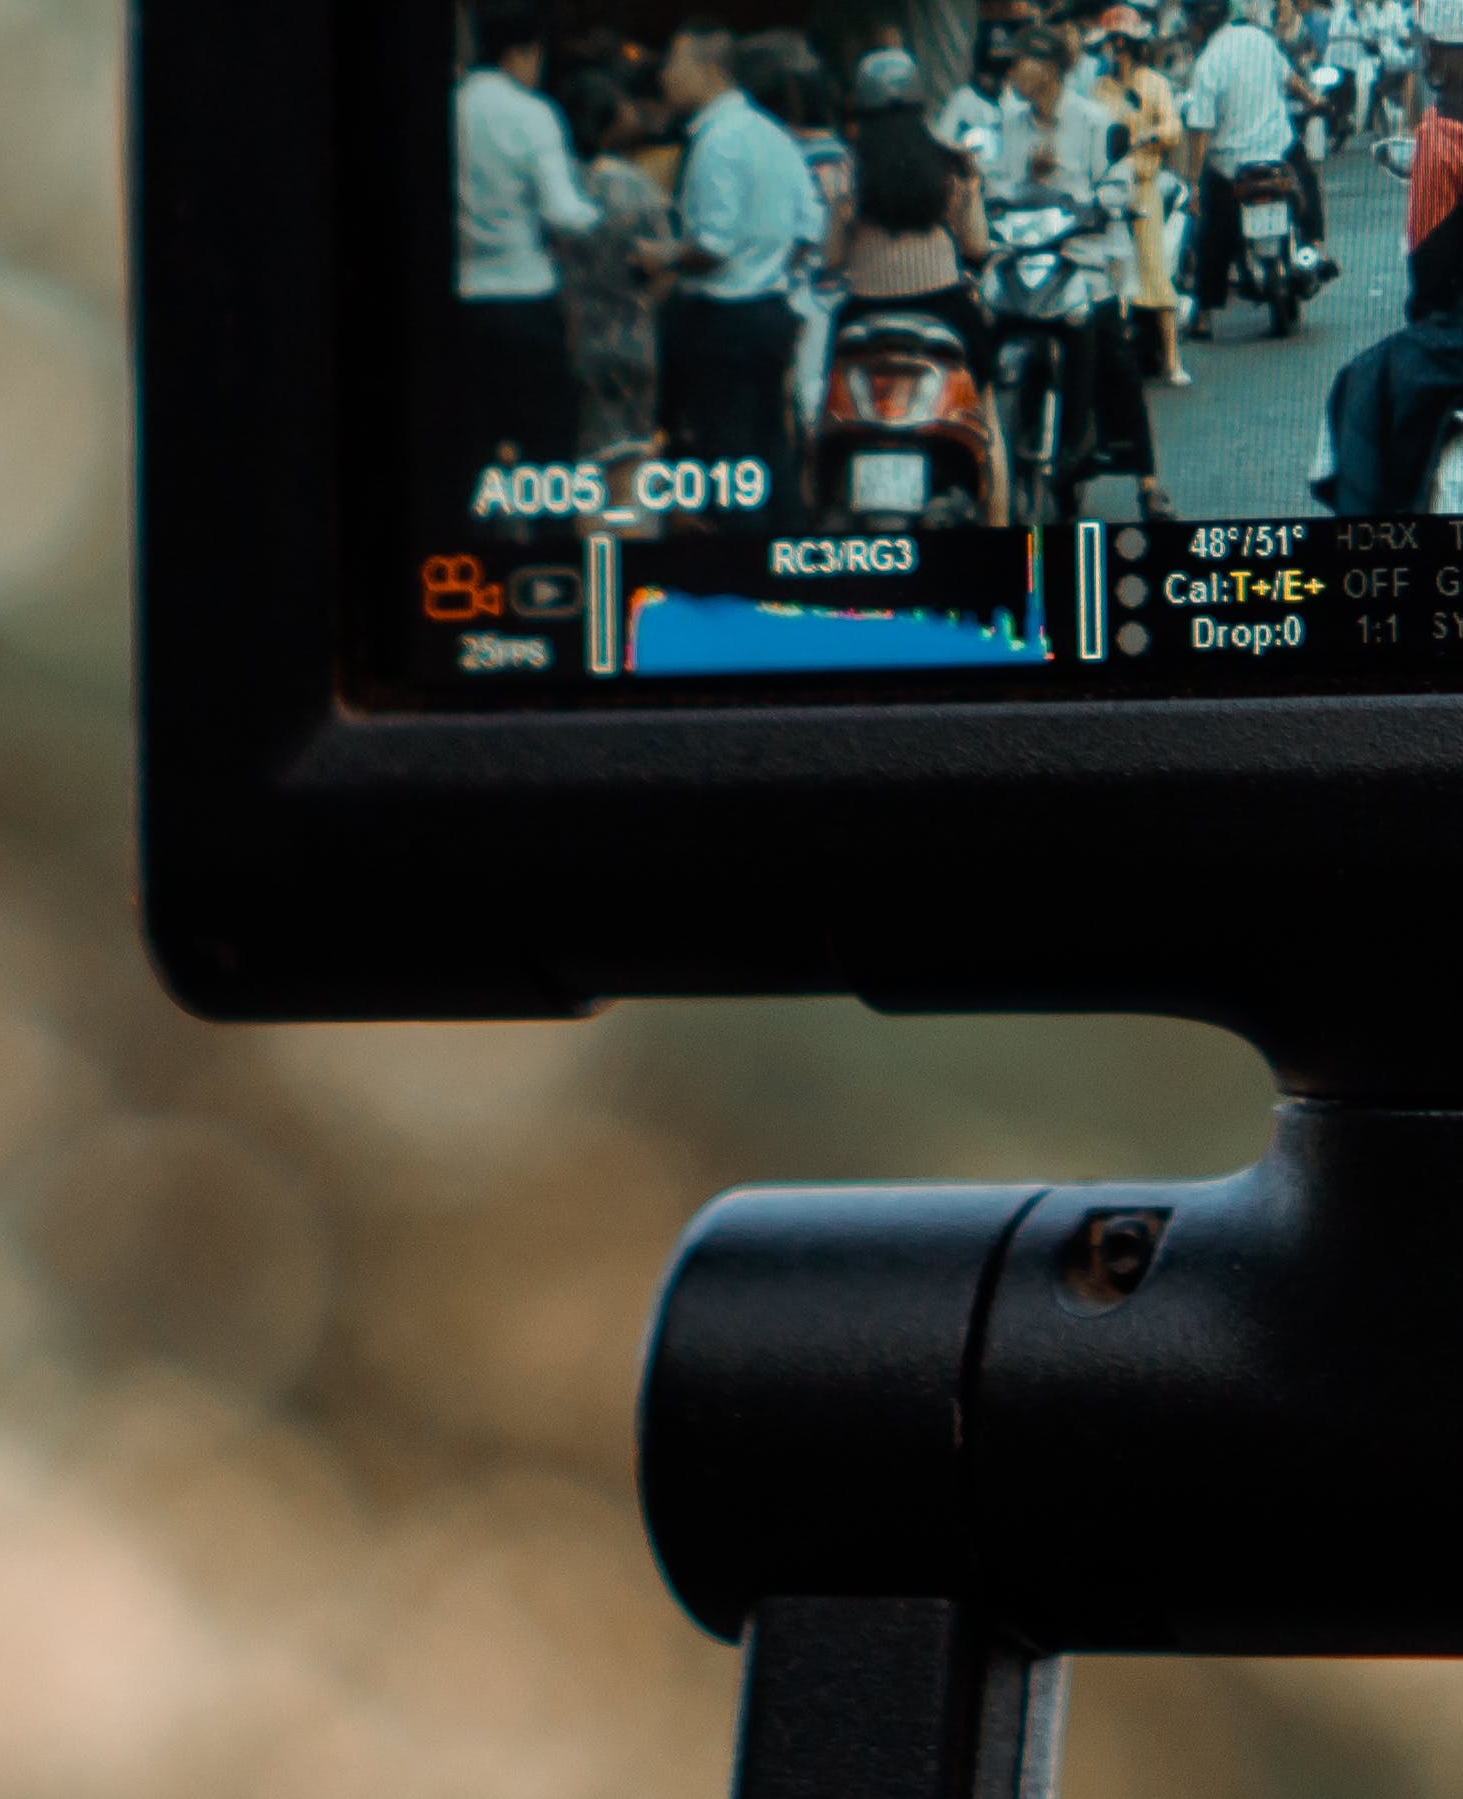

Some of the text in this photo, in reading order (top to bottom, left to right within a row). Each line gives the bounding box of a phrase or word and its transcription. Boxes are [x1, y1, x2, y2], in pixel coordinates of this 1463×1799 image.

[473, 460, 767, 523] A005_C019
[1343, 568, 1410, 598] OFF
[1357, 613, 1398, 643] 1:1
